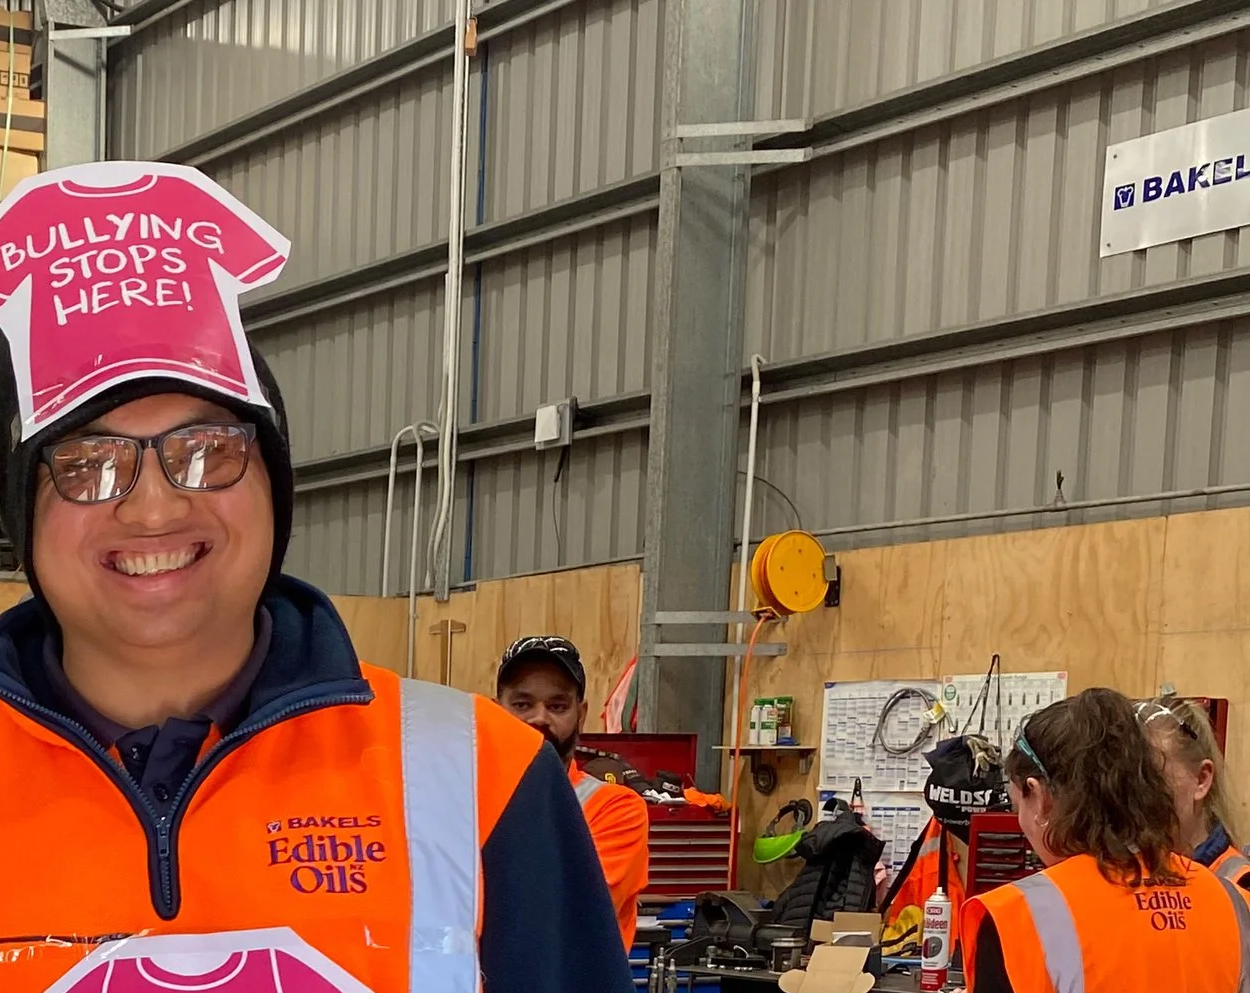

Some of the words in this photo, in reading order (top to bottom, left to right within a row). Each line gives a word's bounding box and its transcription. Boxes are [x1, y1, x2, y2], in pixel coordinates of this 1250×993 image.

[0, 212, 224, 272] BULLYING
[49, 245, 186, 288] STOPS
[53, 278, 193, 326] HERE!
[288, 816, 382, 829] BAKELS
[267, 835, 386, 866] Edible
[290, 865, 368, 894] Oils
[1134, 891, 1192, 911] Edible
[1151, 911, 1186, 931] Oils
